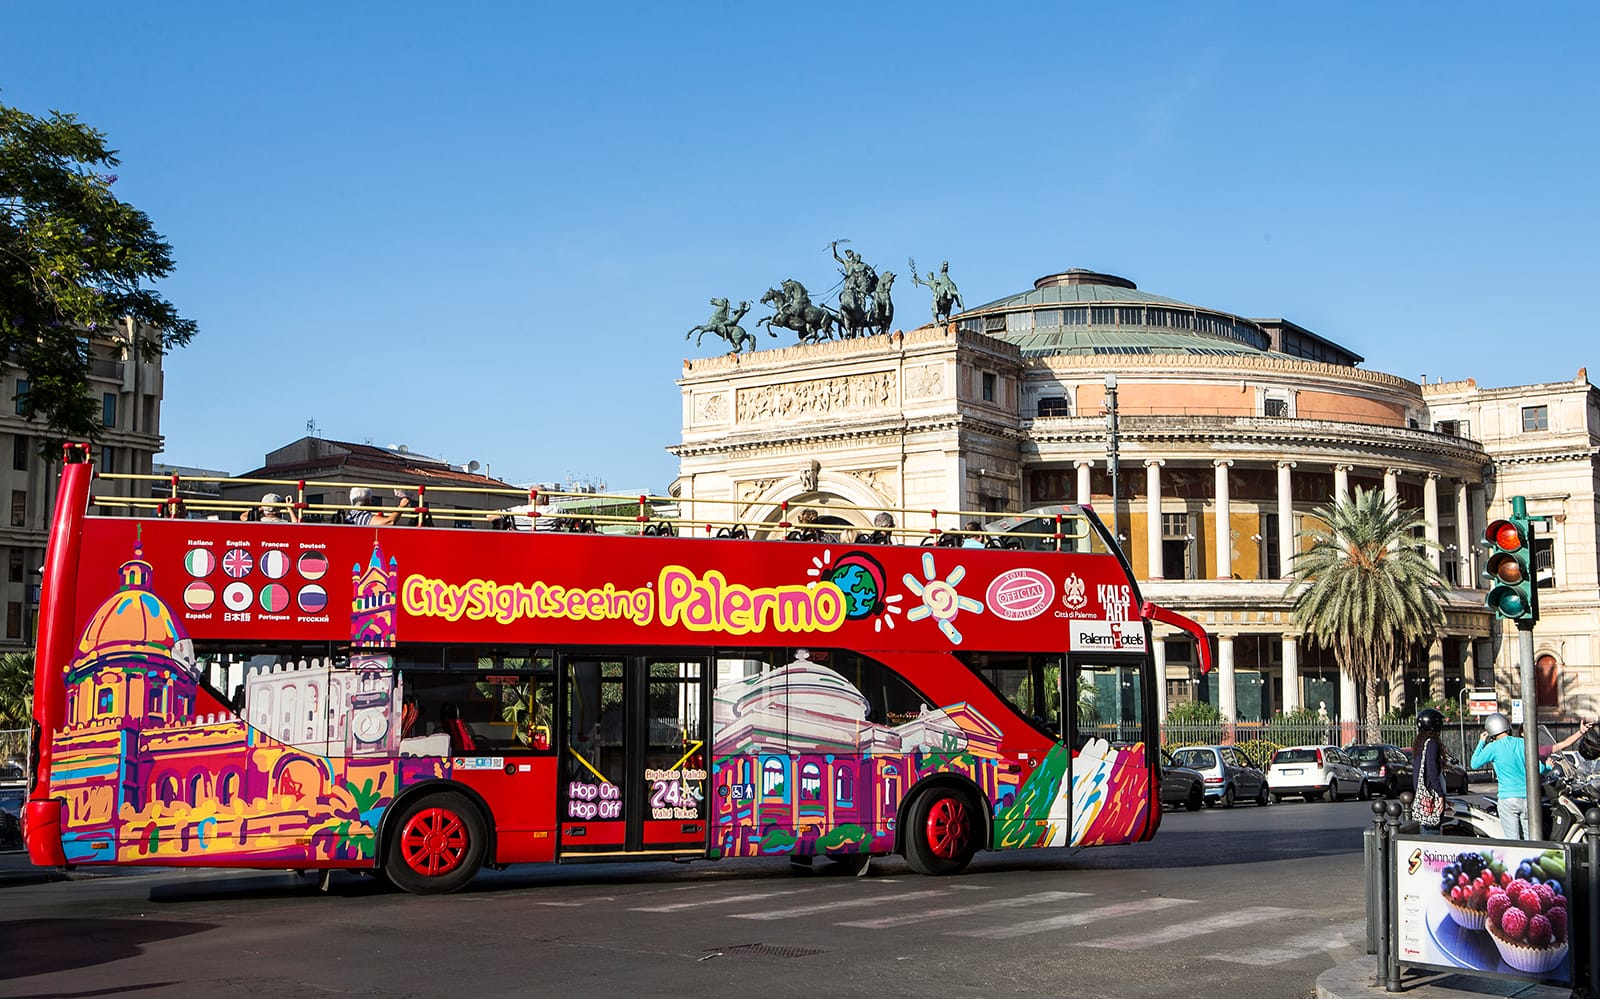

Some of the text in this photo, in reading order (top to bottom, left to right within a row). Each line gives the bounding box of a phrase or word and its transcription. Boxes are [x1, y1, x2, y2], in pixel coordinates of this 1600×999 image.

[1006, 571, 1027, 580] TOUR
[658, 565, 848, 635] Palermo
[1000, 585, 1043, 603] OFFICIAL
[1016, 601, 1045, 618] PALERMO
[1075, 611, 1097, 619] Palermo
[645, 769, 707, 780] Biglietto Valido
[569, 782, 620, 800] Hop On
[569, 801, 622, 819] Hop Off
[652, 808, 698, 819] Valid Ticket
